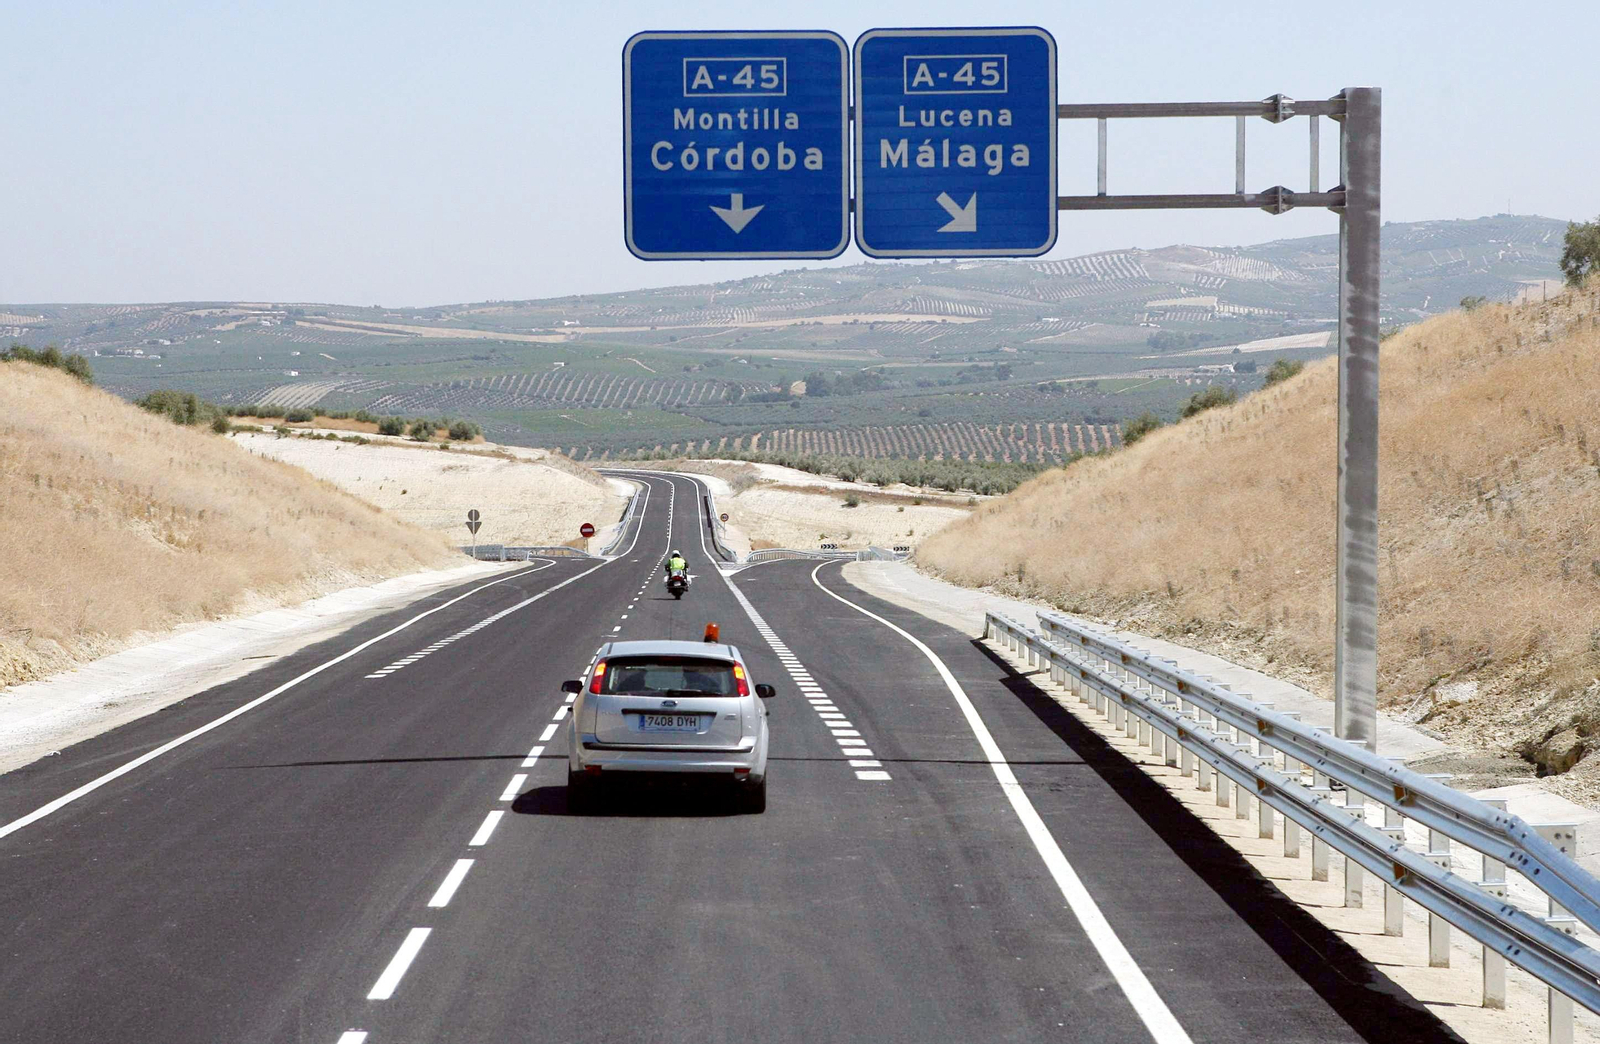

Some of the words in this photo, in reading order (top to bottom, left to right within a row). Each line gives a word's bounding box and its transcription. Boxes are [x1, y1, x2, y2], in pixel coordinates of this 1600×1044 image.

[693, 65, 779, 89] A-45
[912, 61, 1001, 88] A-45
[674, 108, 799, 130] Montilla
[899, 105, 1012, 127] Lucena
[651, 141, 823, 170] Córdoba
[880, 139, 1029, 175] Málaga
[647, 716, 673, 727] 7408
[677, 716, 696, 727] DYH
